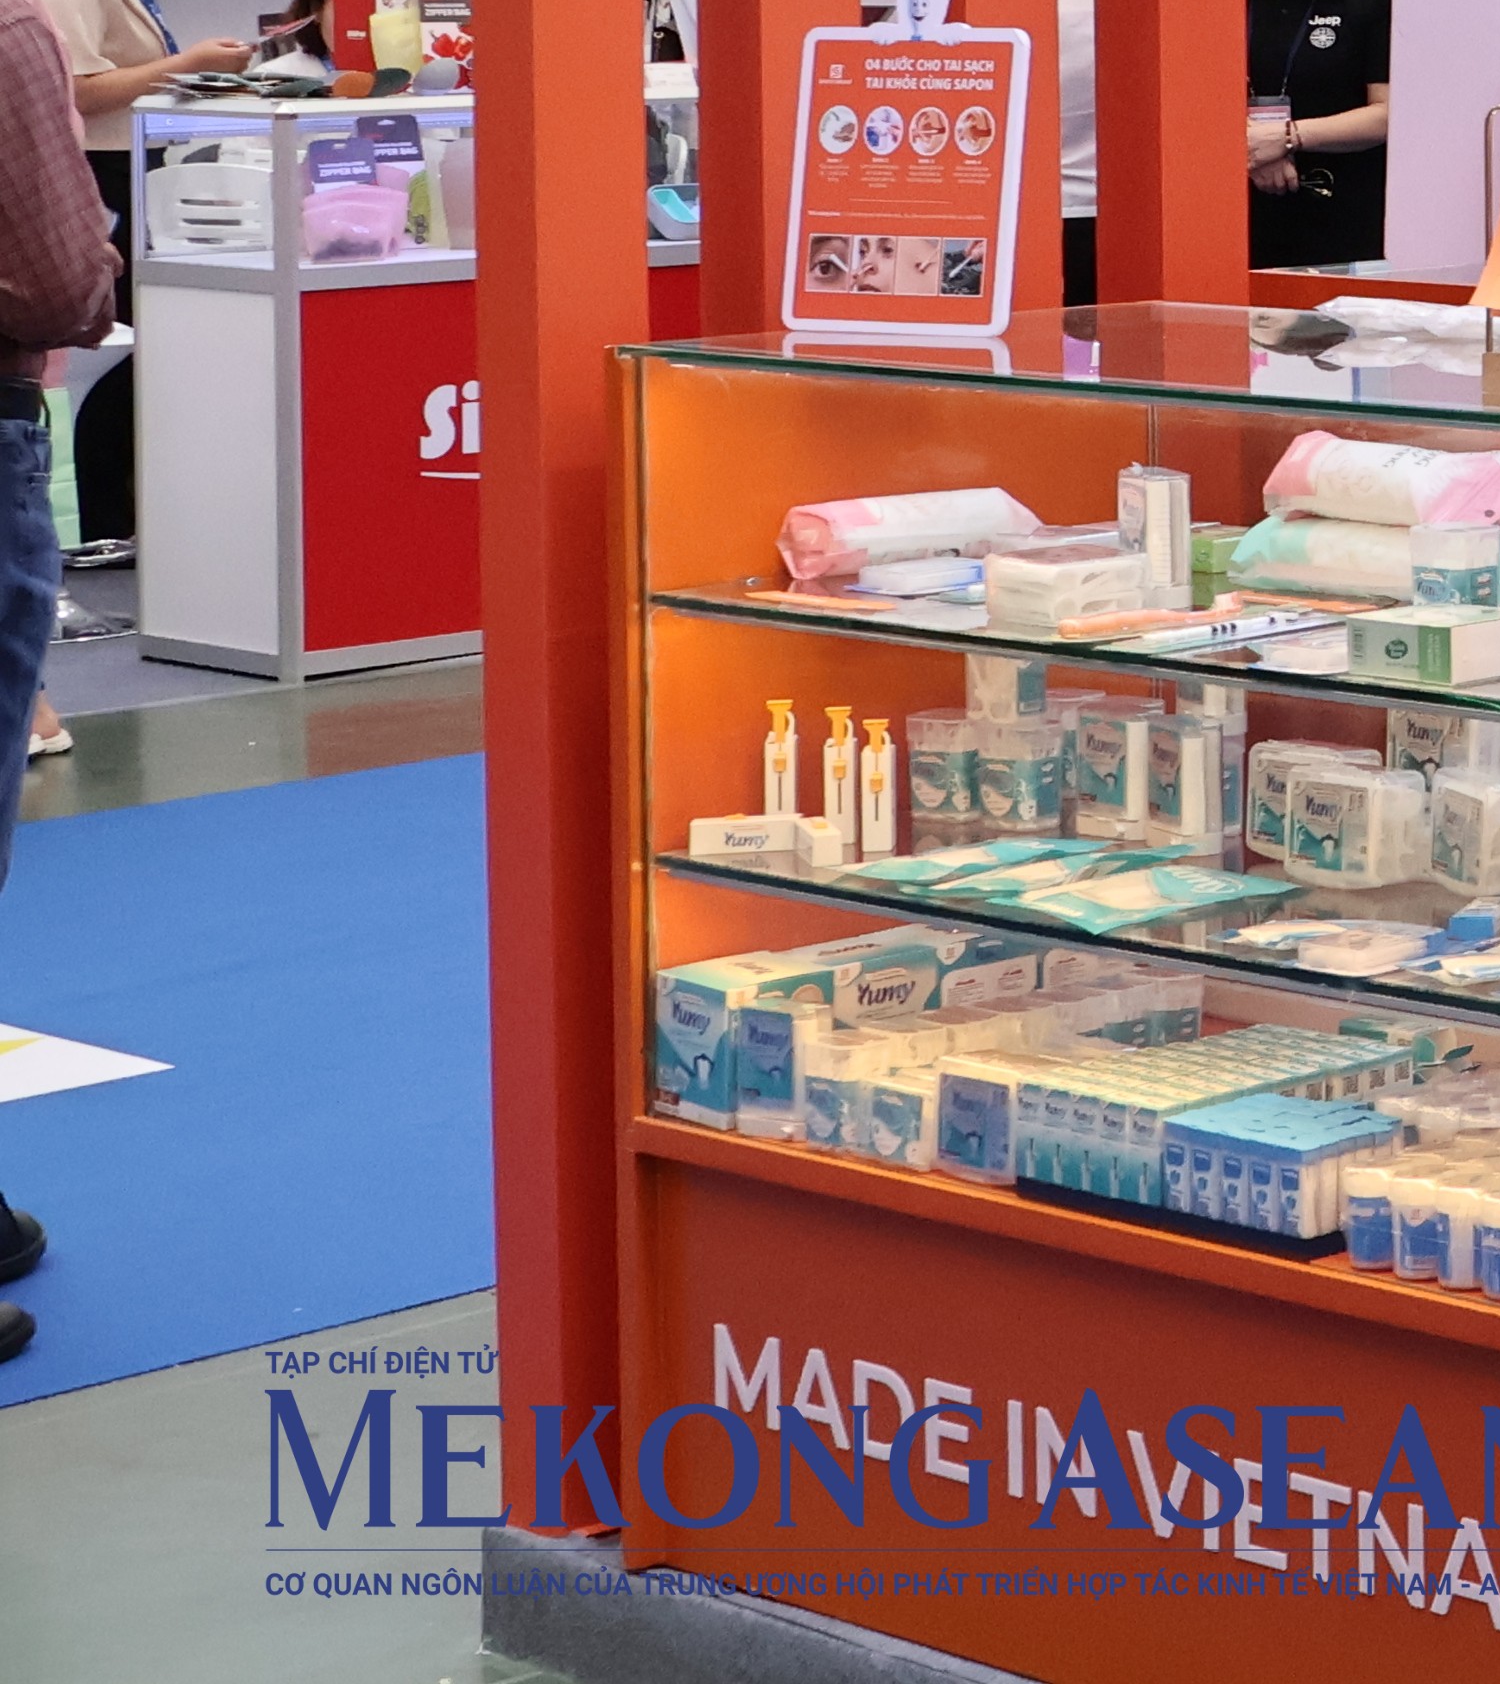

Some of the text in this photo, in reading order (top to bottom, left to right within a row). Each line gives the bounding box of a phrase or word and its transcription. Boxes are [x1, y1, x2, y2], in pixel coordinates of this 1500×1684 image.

[1308, 14, 1341, 28] Jeep
[708, 1322, 974, 1482] MADE
[1006, 1396, 1100, 1520] IN
